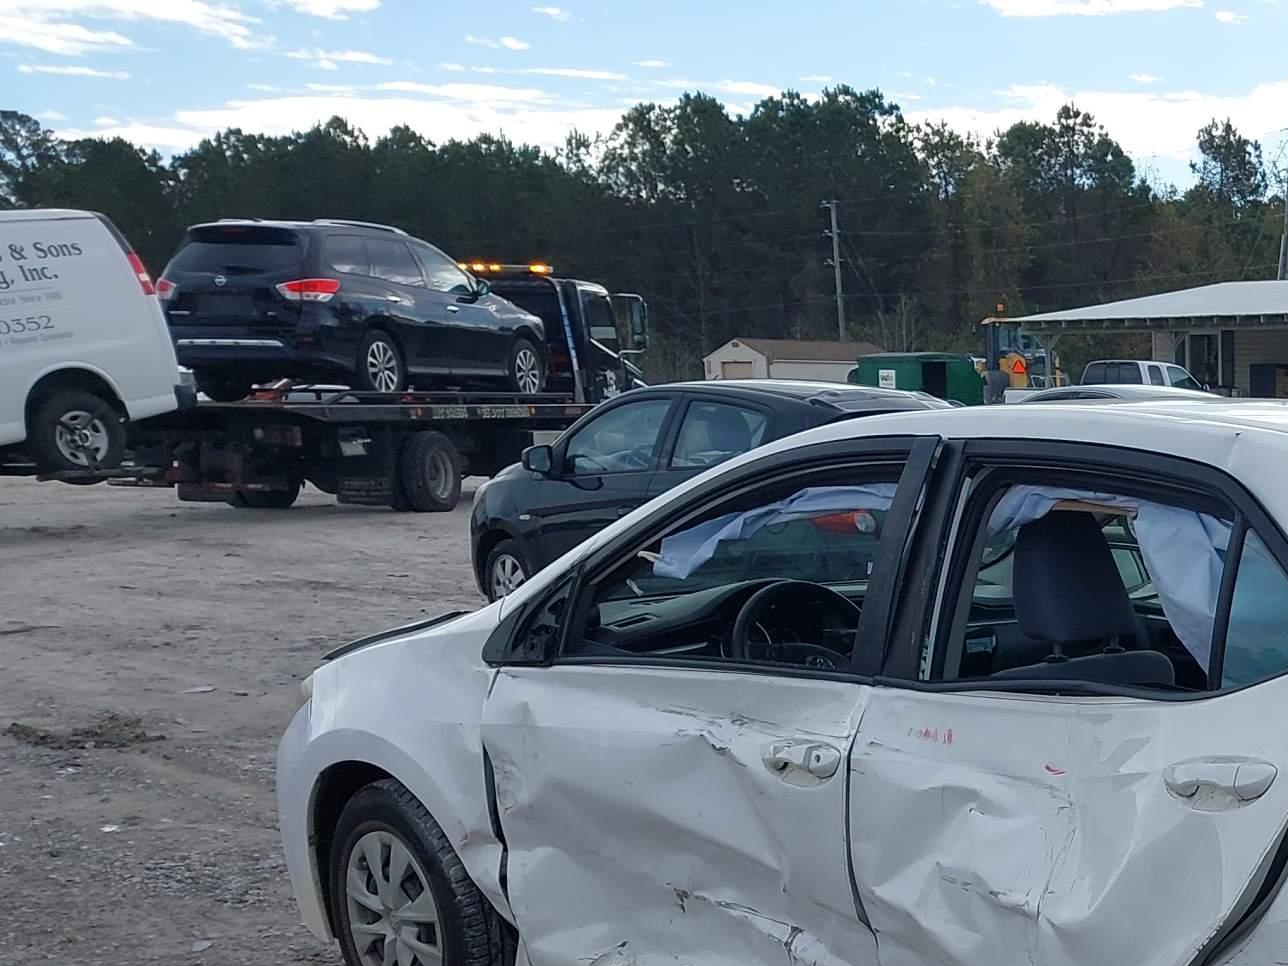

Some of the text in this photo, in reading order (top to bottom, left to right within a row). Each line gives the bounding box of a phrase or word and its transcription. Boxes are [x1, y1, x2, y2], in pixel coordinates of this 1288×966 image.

[8, 243, 28, 261] &
[32, 241, 83, 259] Sons
[17, 264, 59, 282] Inc.
